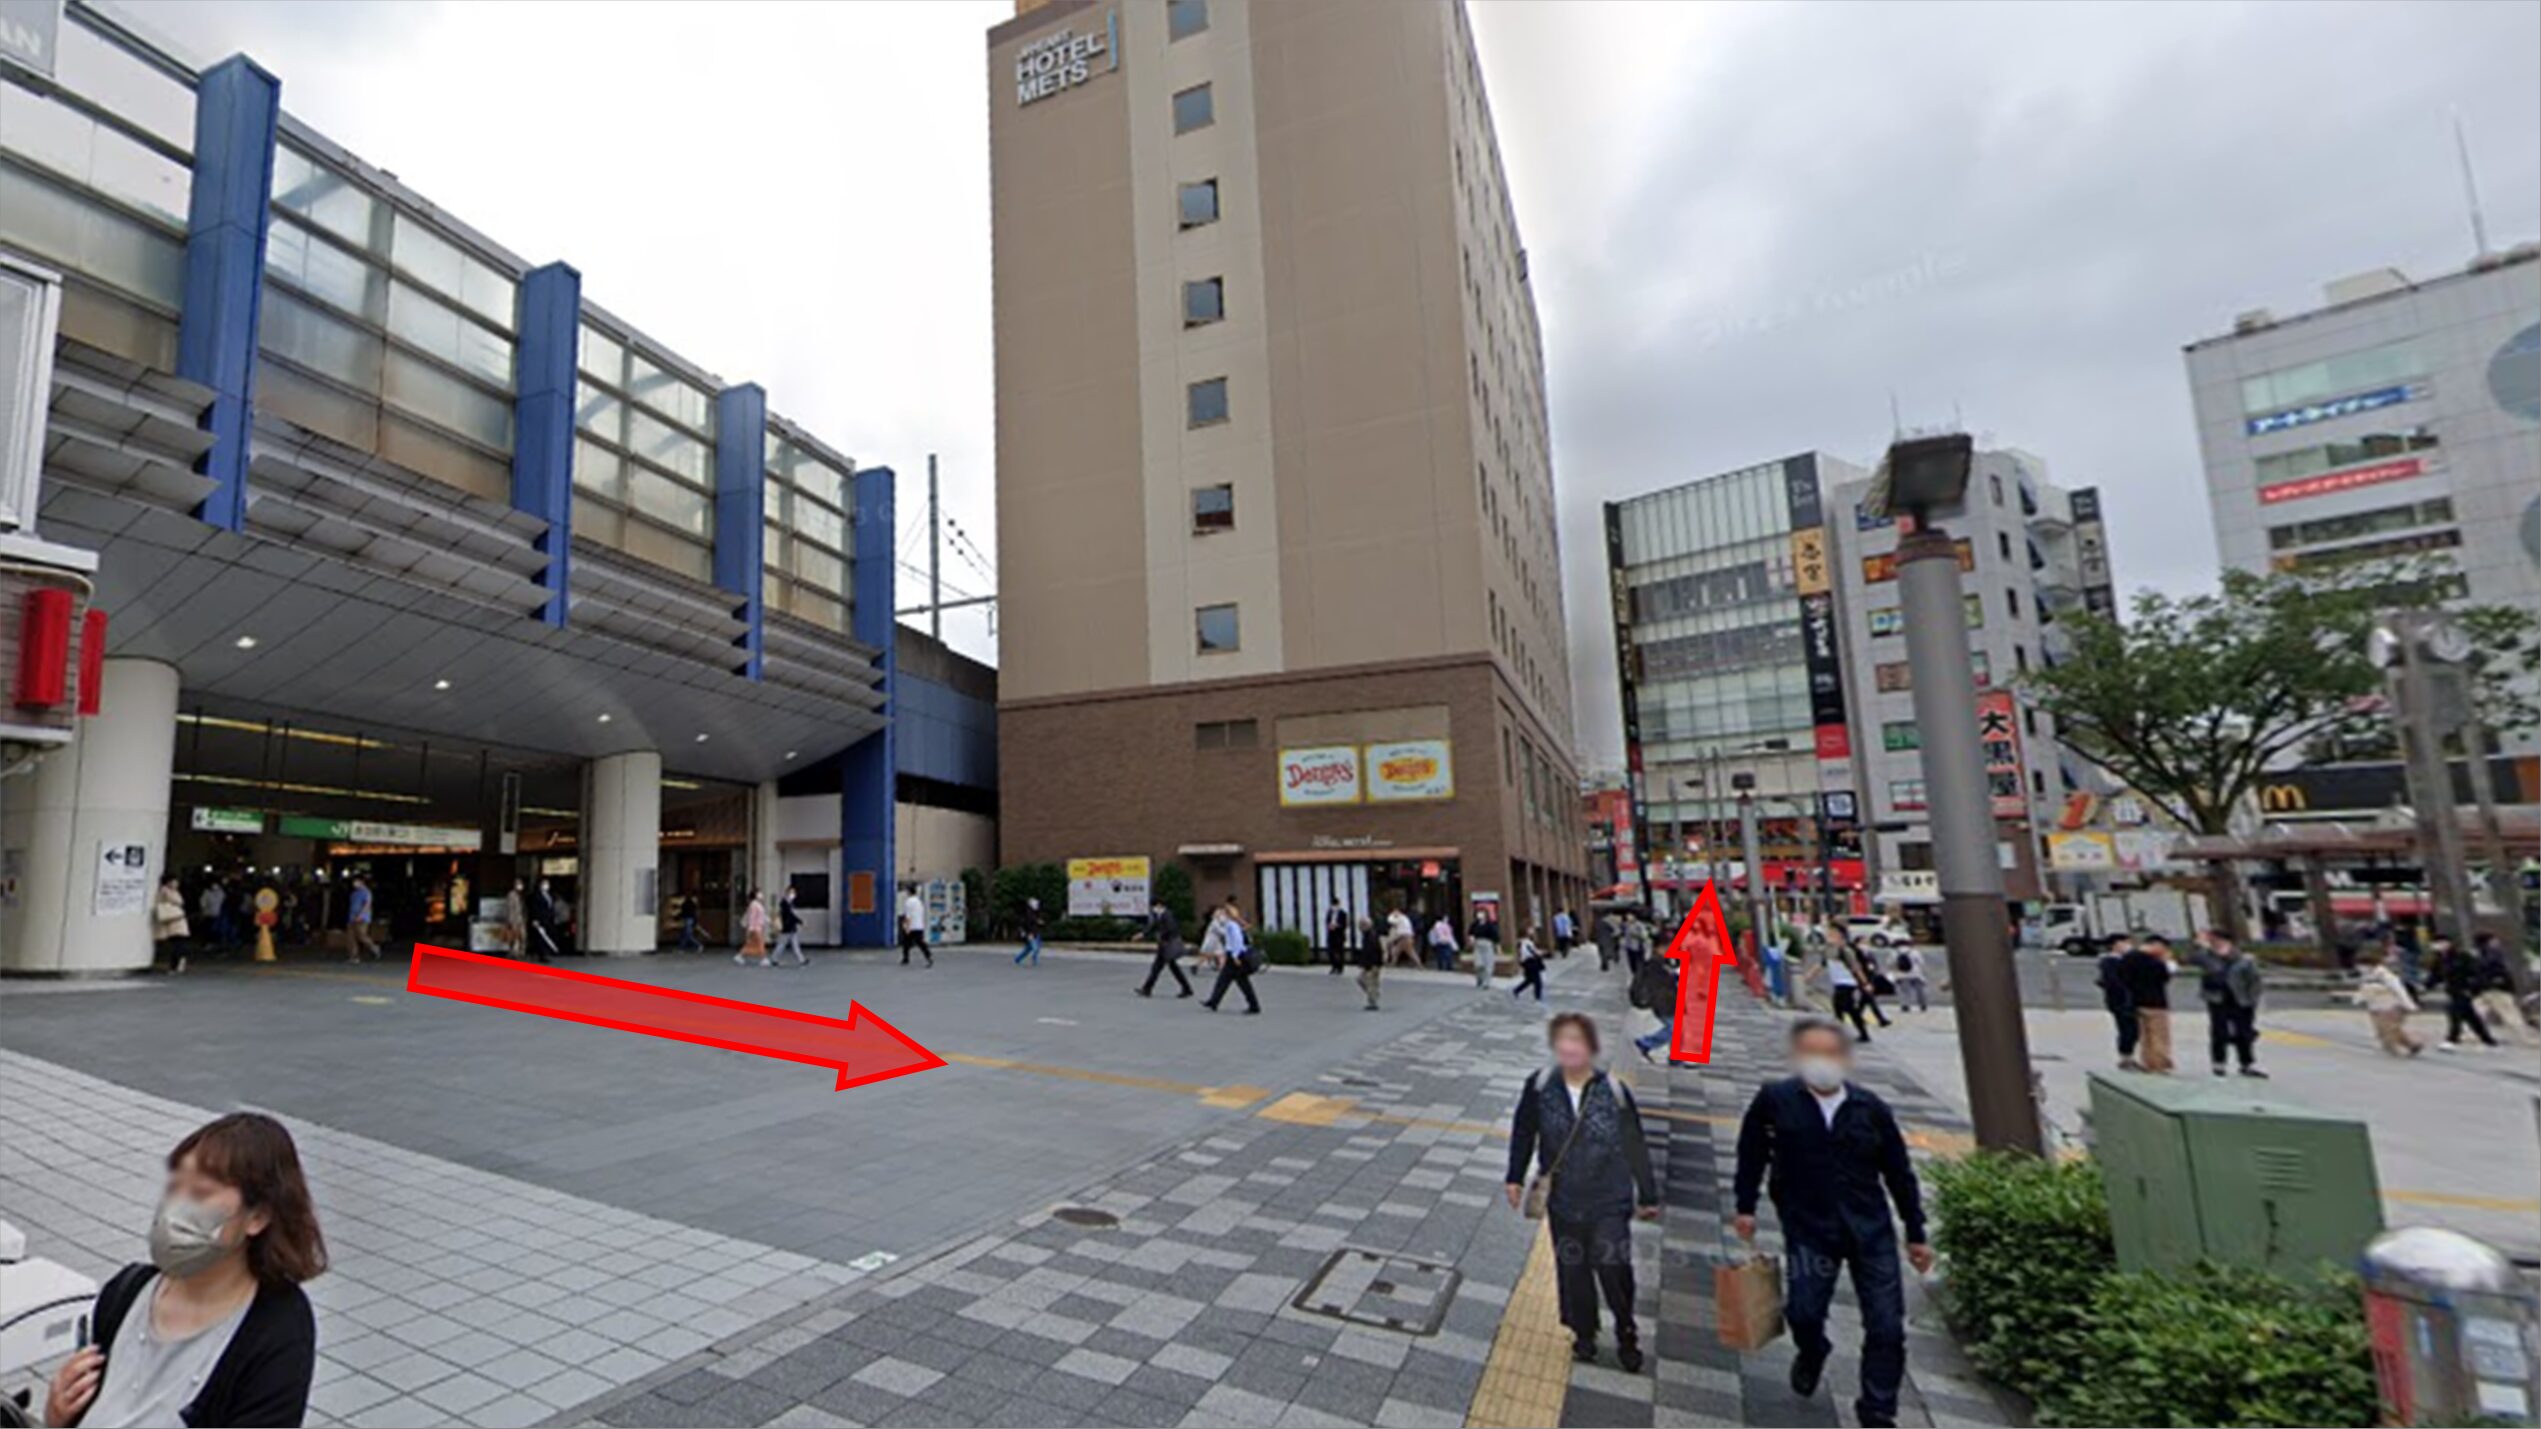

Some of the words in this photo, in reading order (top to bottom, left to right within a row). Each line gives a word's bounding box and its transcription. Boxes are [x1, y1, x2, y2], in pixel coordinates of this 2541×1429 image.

[1017, 33, 1104, 81] HOTEL
[1018, 60, 1087, 105] METS
[1980, 709, 2017, 796] 大黒屋
